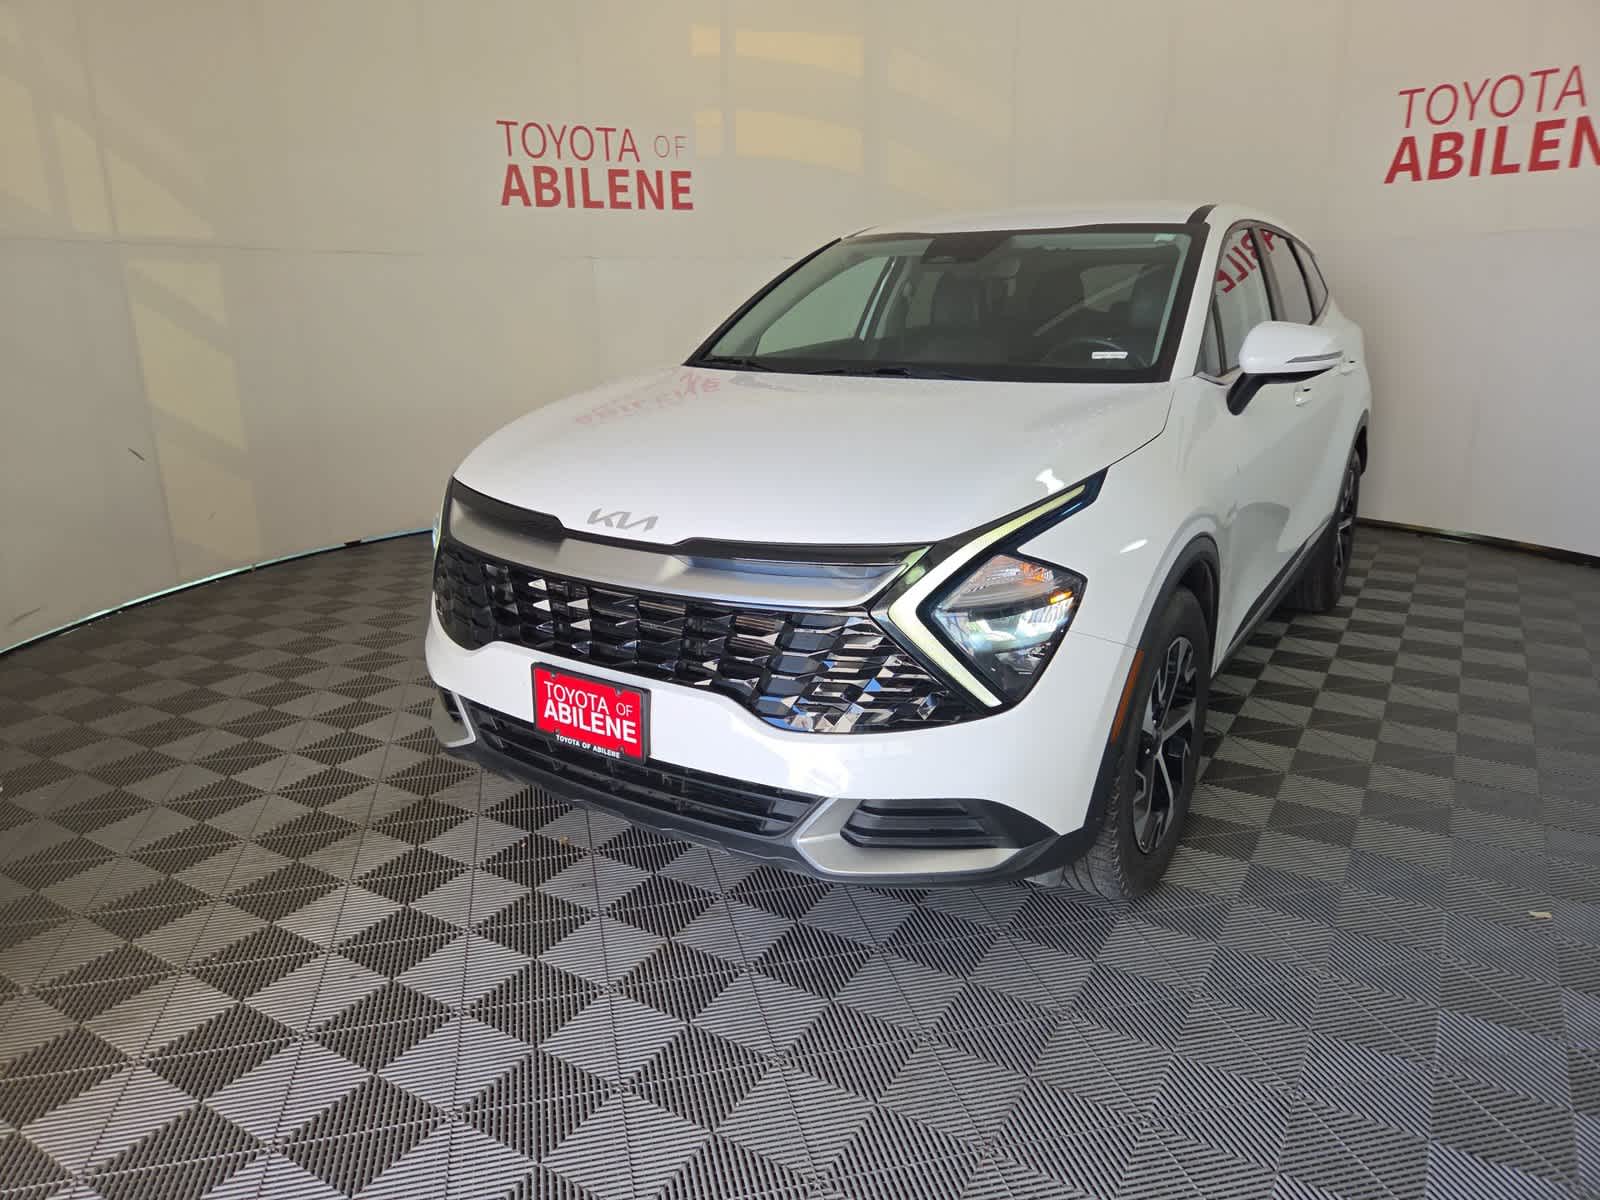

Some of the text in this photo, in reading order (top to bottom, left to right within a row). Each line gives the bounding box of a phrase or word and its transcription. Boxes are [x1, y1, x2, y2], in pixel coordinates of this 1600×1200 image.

[1398, 65, 1588, 128] TOYOTA
[496, 120, 687, 163] TOYOTA OF
[501, 164, 694, 210] ABILENE
[543, 680, 633, 717] TOYOTA OF
[543, 699, 638, 744] ABILENE
[556, 734, 621, 759] TOYOTA OF ABILENE
